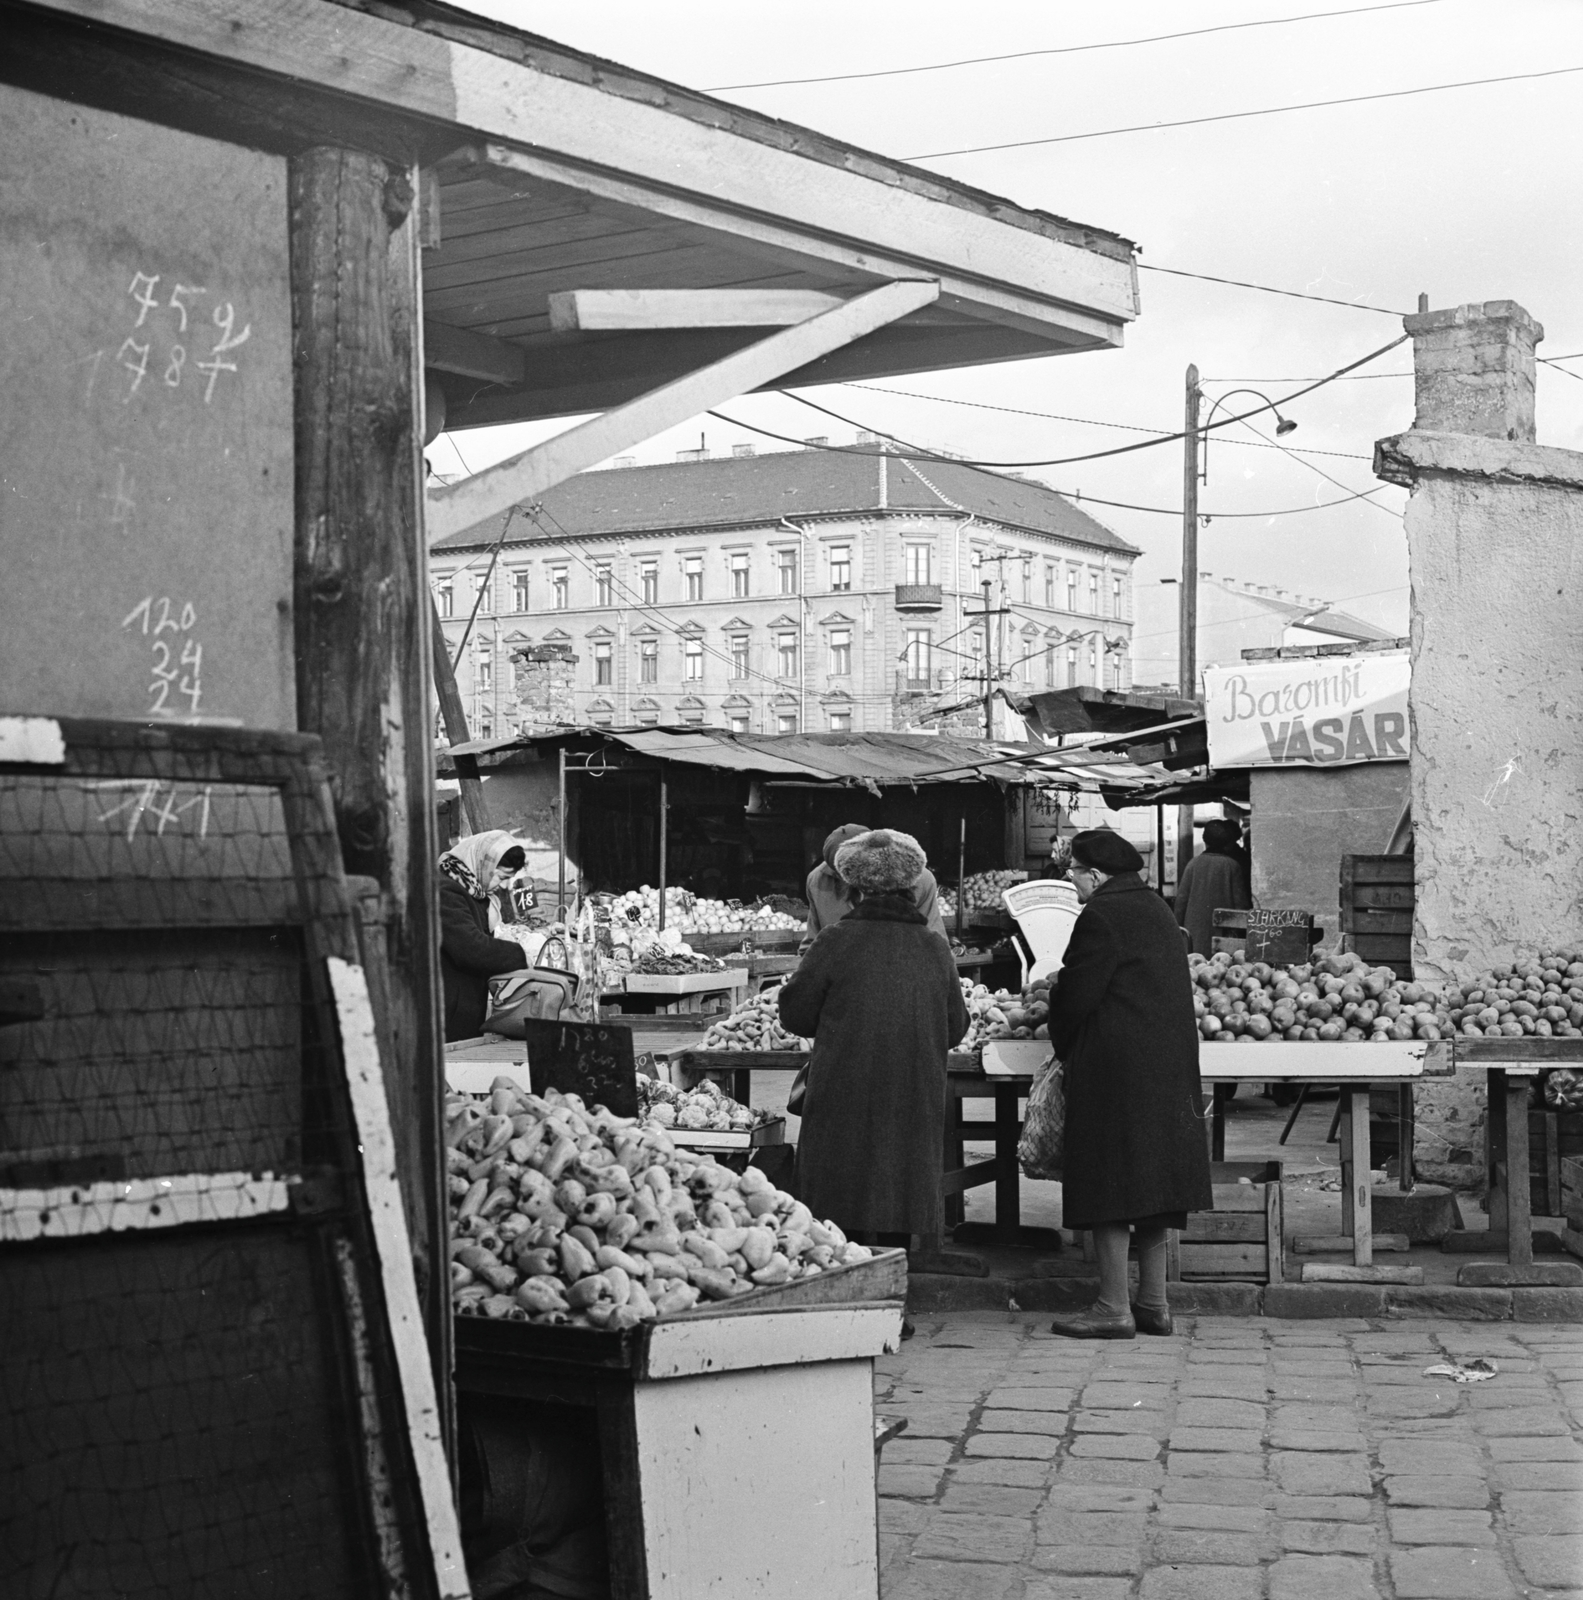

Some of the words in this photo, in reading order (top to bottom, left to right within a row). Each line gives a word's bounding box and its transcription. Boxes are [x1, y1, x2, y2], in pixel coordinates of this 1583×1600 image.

[121, 596, 197, 635] 120
[151, 638, 202, 680] 24
[148, 675, 202, 713] 24
[1223, 662, 1368, 723] Baromfi
[1260, 709, 1408, 763] VÁSÁR
[517, 892, 534, 910] 18
